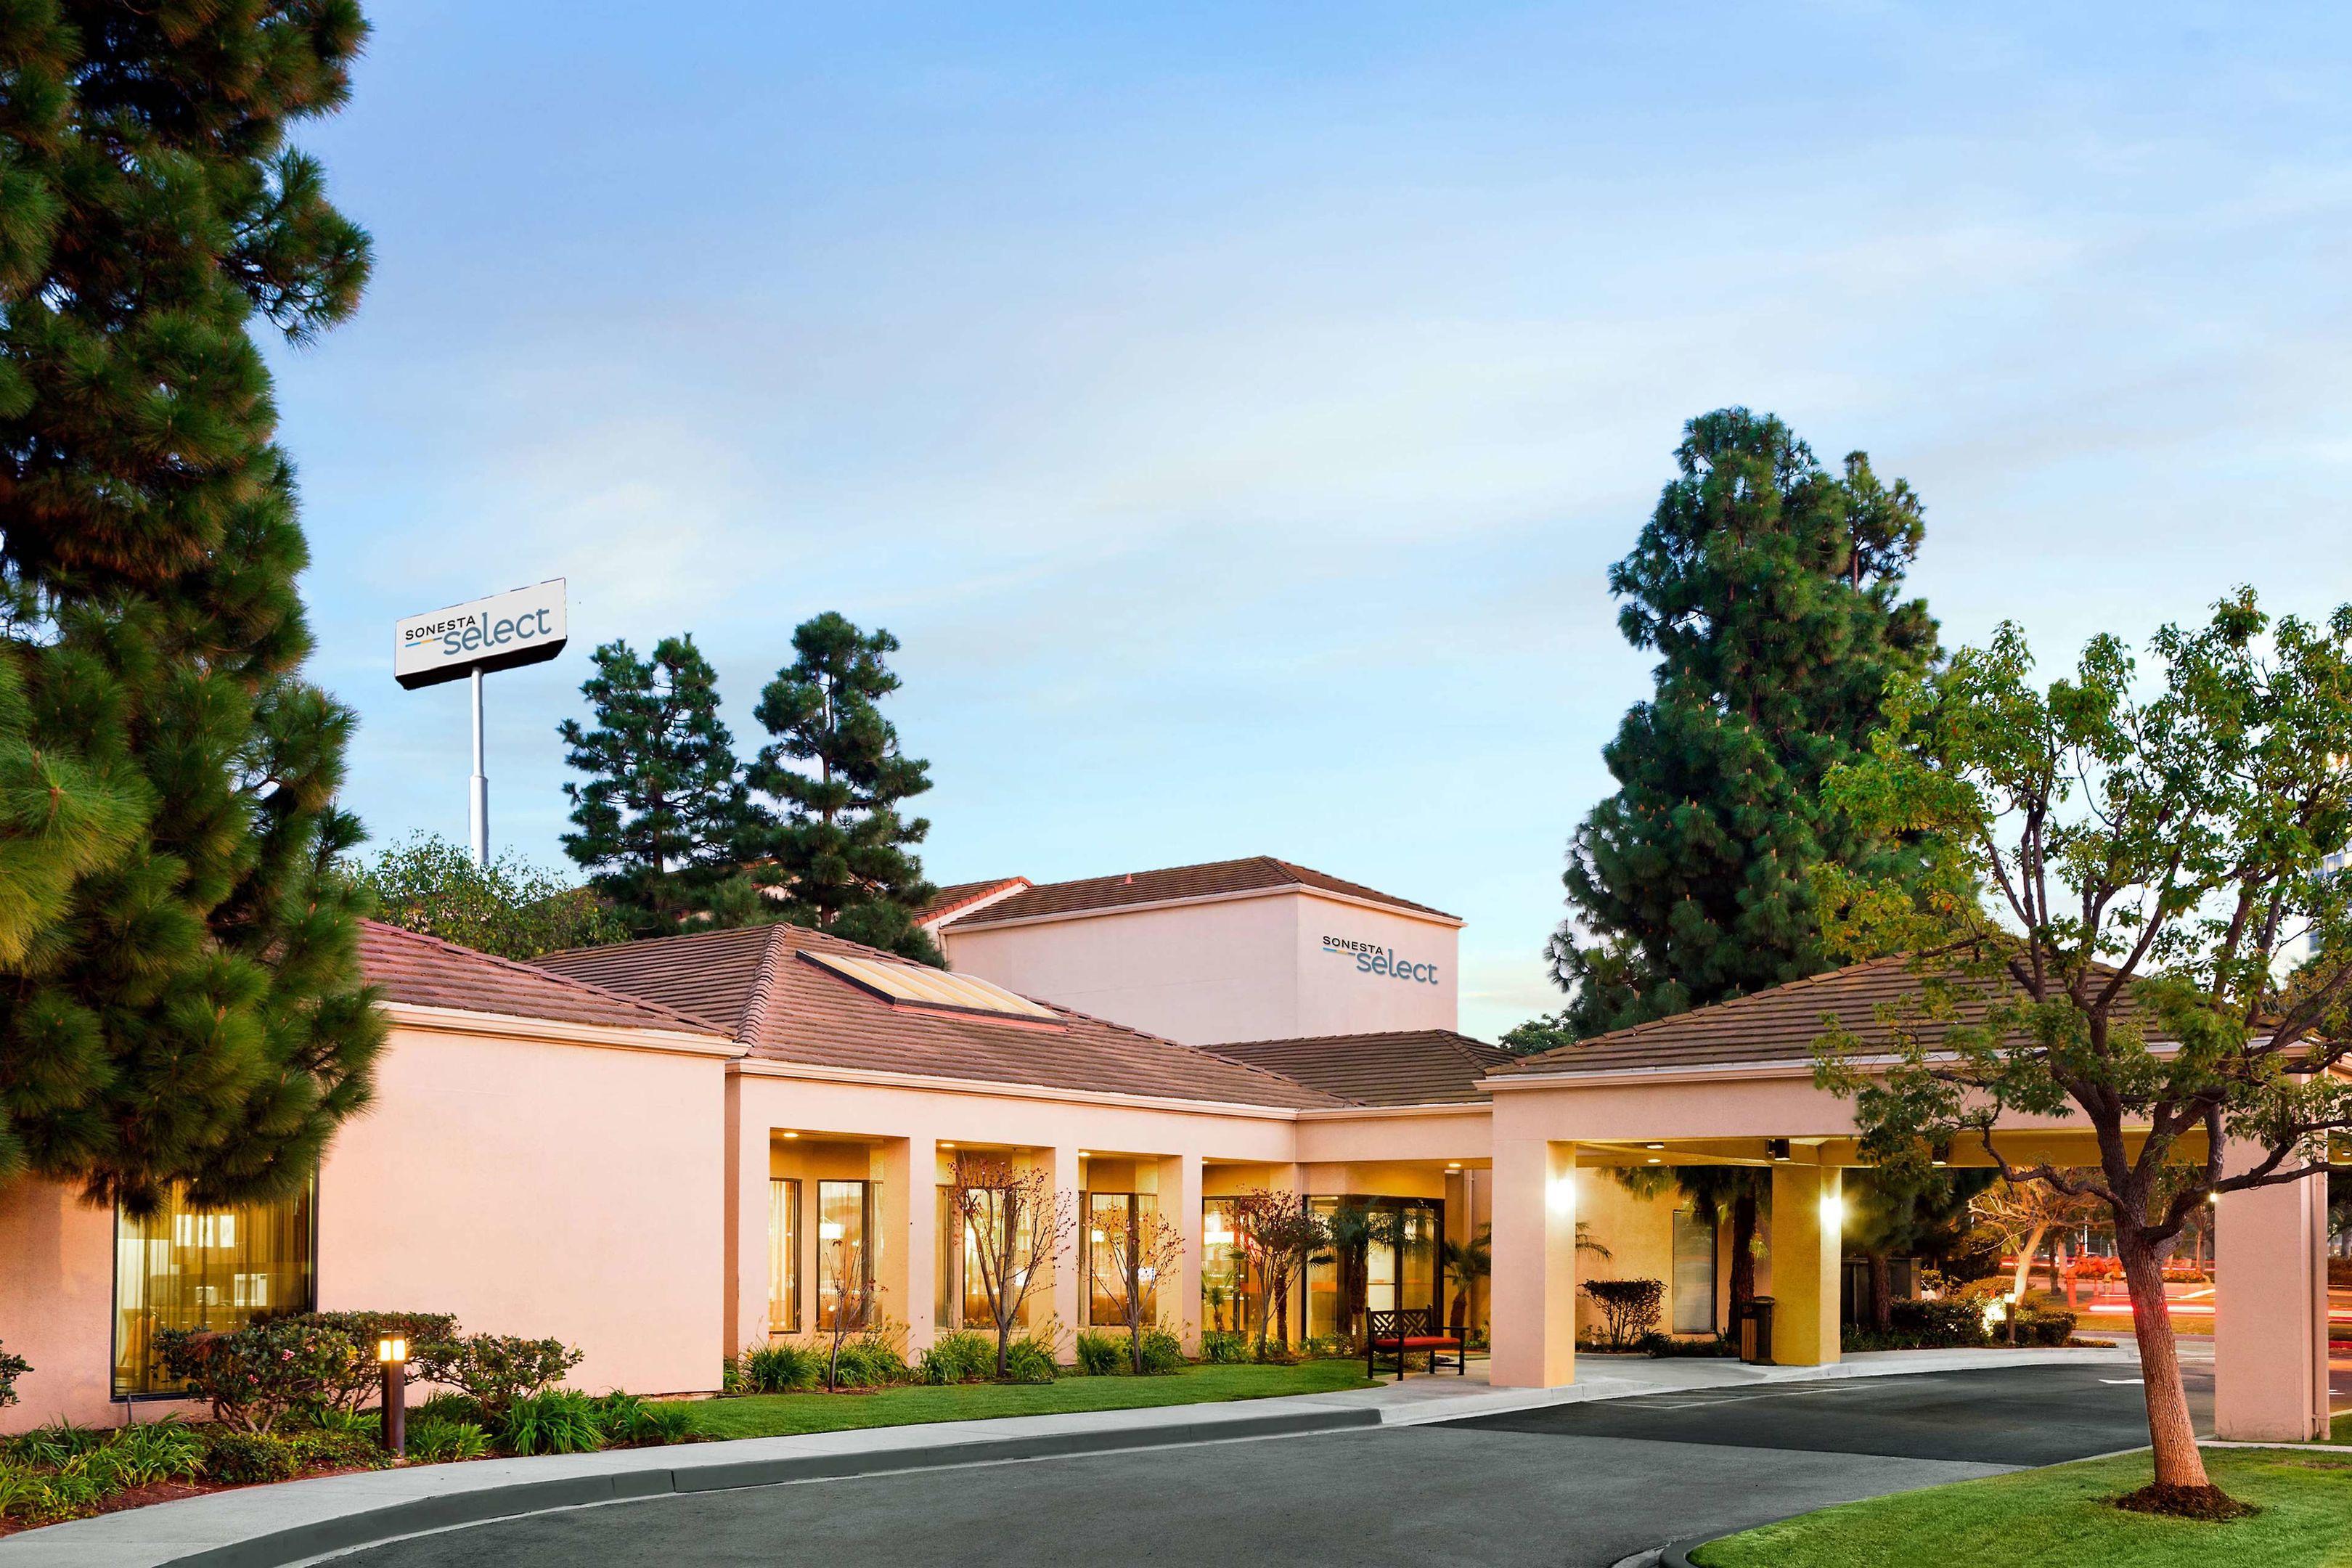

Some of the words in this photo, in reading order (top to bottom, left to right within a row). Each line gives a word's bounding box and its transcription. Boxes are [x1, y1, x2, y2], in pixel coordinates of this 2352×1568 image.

[405, 616, 476, 640] SONESTA
[443, 608, 552, 655] select
[1323, 936, 1384, 955] SONESTA
[1356, 948, 1438, 984] select
